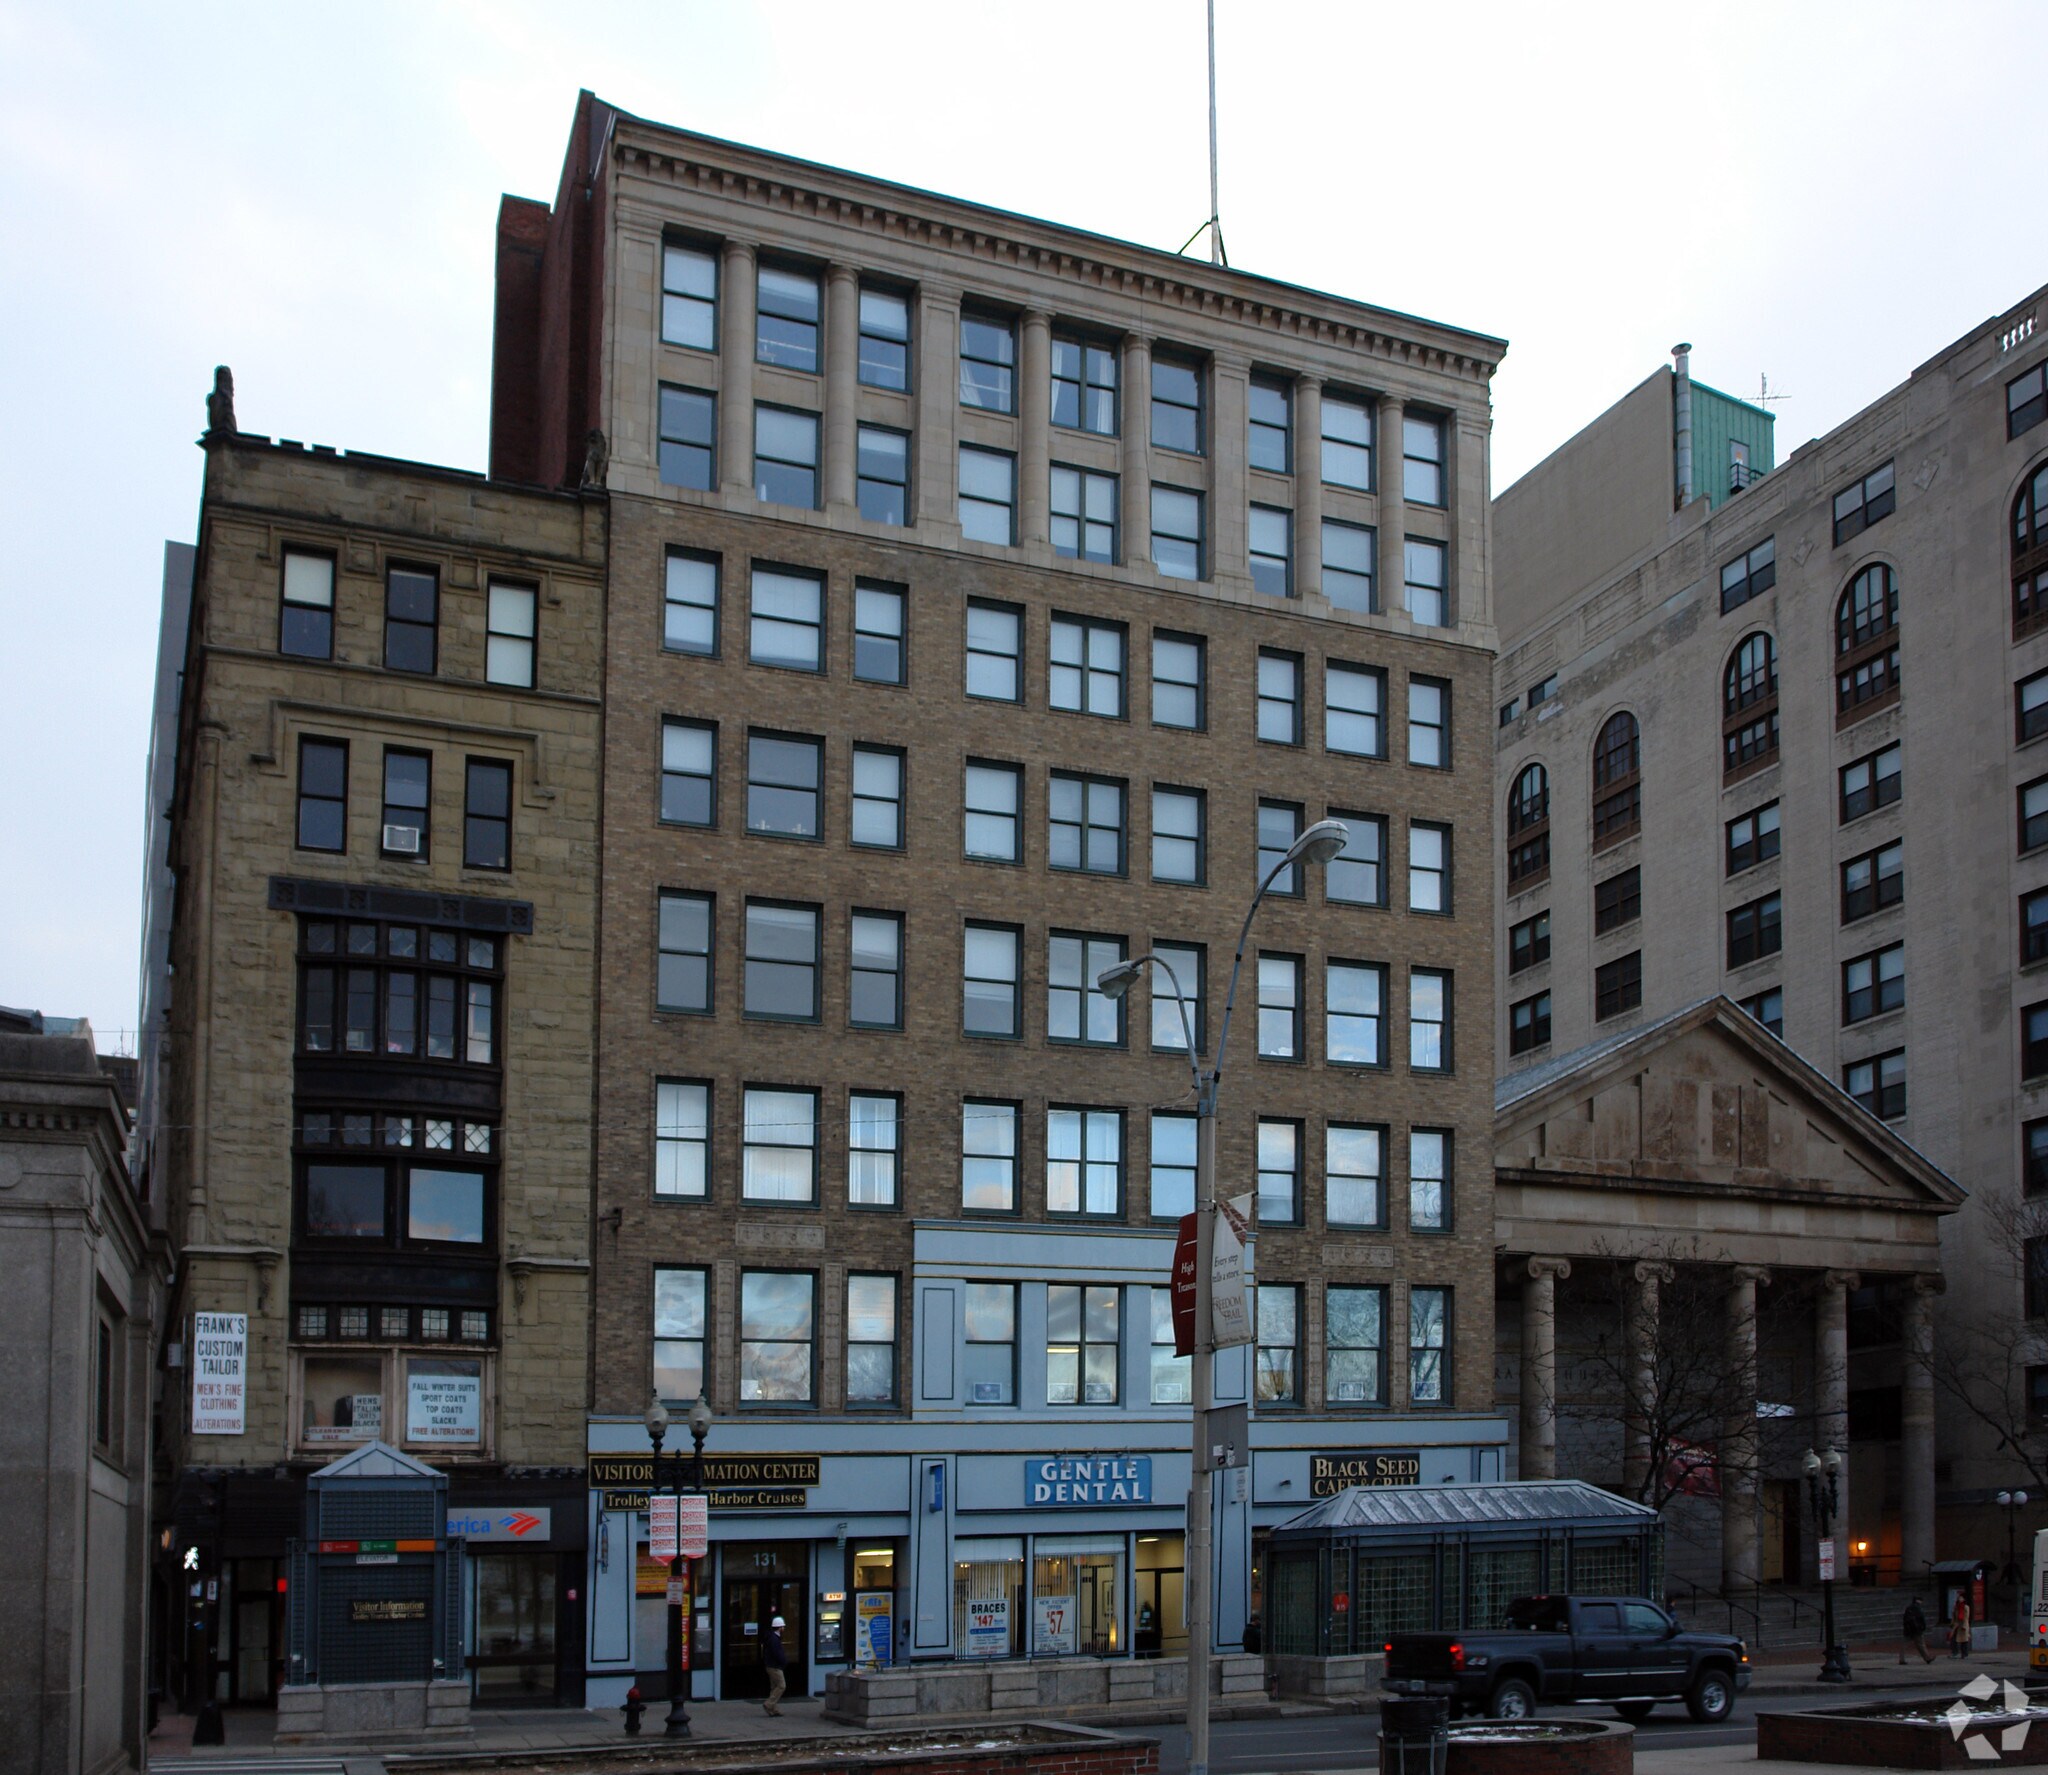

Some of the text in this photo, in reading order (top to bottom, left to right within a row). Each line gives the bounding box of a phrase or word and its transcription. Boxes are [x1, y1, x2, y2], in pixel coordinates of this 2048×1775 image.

[1181, 1261, 1194, 1275] High
[1214, 1254, 1238, 1268] Every step
[1177, 1282, 1196, 1294] Treason
[1212, 1295, 1242, 1311] FREEDOM
[196, 1317, 245, 1334] FRANK'S
[198, 1340, 243, 1357] CUSTOM
[201, 1359, 238, 1375] TAILOR
[197, 1383, 242, 1396] MEN'S FINE
[412, 1383, 476, 1392] FALL WINTER SUITS
[200, 1398, 237, 1410] CLOTHING
[421, 1394, 467, 1403] SPORT COATS
[425, 1405, 463, 1414] TOP COATS
[194, 1419, 241, 1431] ALTERATIONS
[431, 1417, 457, 1425] SLACKS
[412, 1427, 428, 1435] FREE
[593, 1463, 816, 1480] VISITOR MATION CENTER
[1041, 1461, 1138, 1481] GENTLE
[1315, 1457, 1418, 1477] BLACK SEED
[1034, 1482, 1144, 1502] DENTAL
[606, 1491, 805, 1508] Trolley Harbor Cruises
[447, 1515, 491, 1534] erica
[752, 1552, 777, 1566] 131
[353, 1600, 425, 1611] Visitor Information
[971, 1603, 1006, 1614] BRACES
